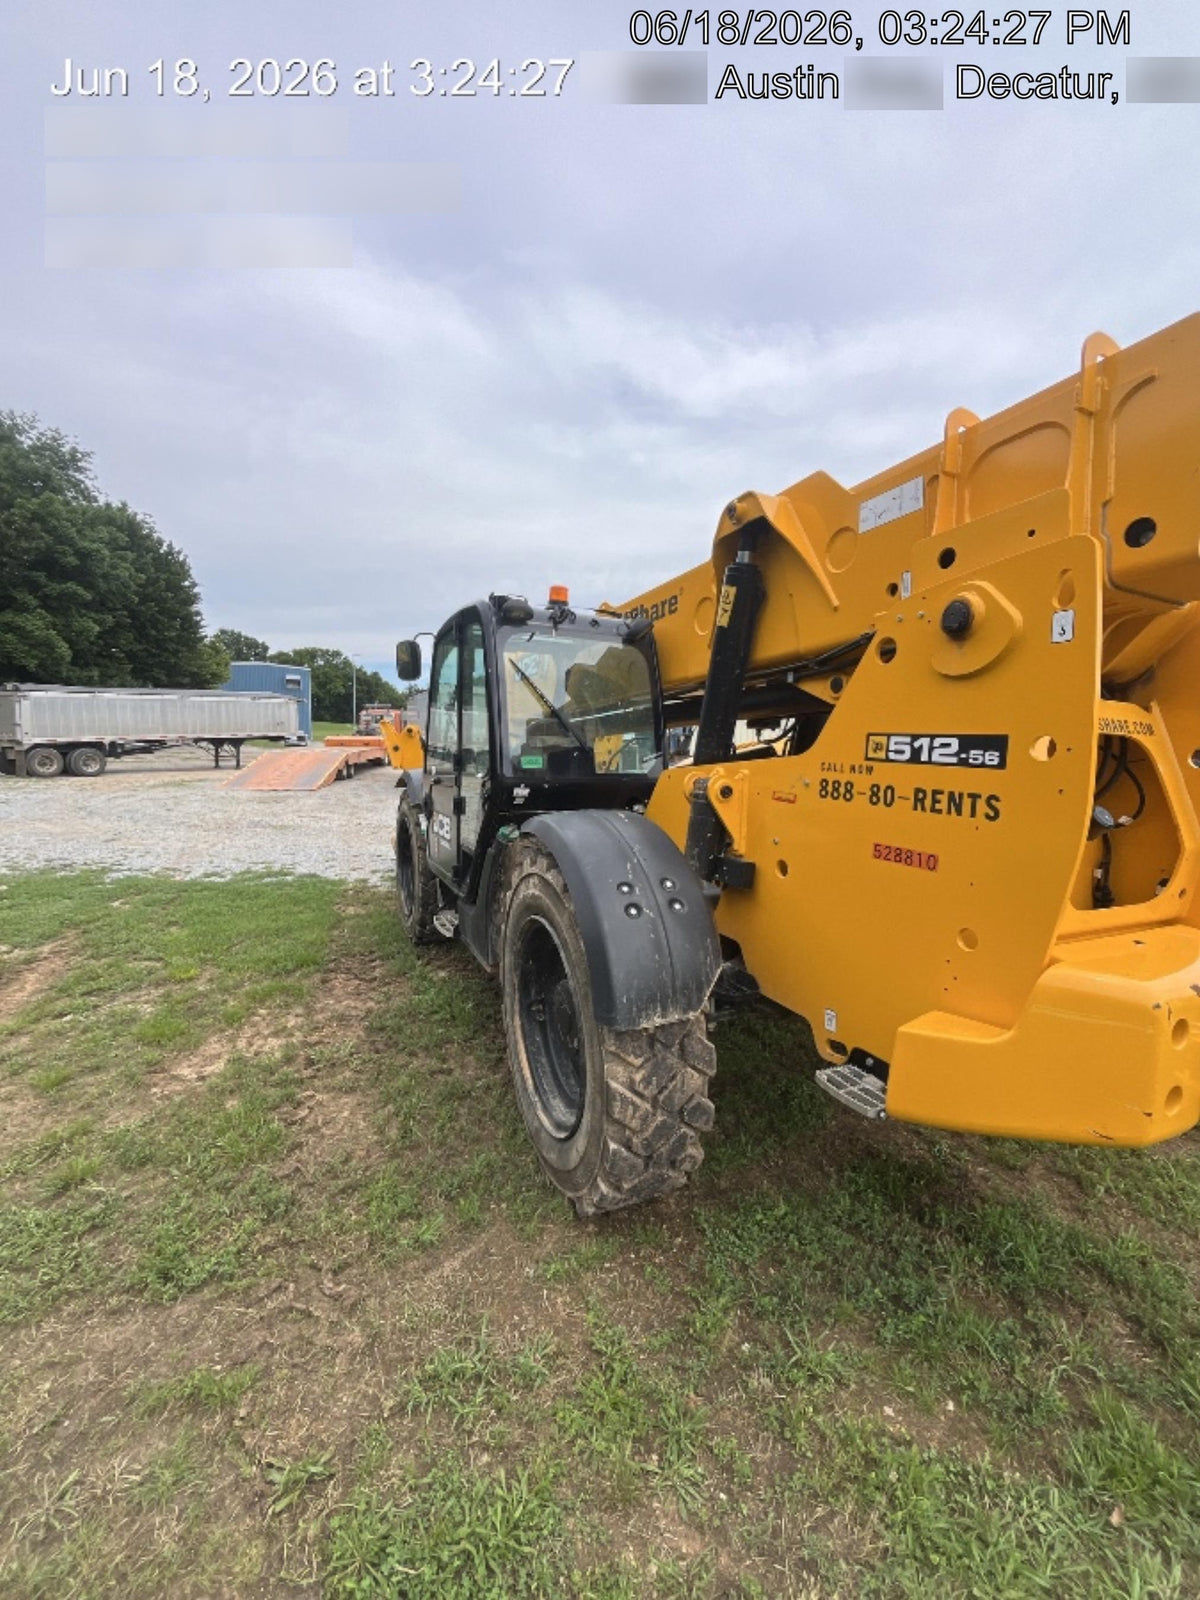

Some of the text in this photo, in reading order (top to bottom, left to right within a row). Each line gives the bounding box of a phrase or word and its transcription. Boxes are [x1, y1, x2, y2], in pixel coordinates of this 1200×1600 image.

[821, 762, 874, 776] CALL NOW
[819, 778, 1001, 822] 888-80-RENTS
[873, 843, 939, 872] 528810
